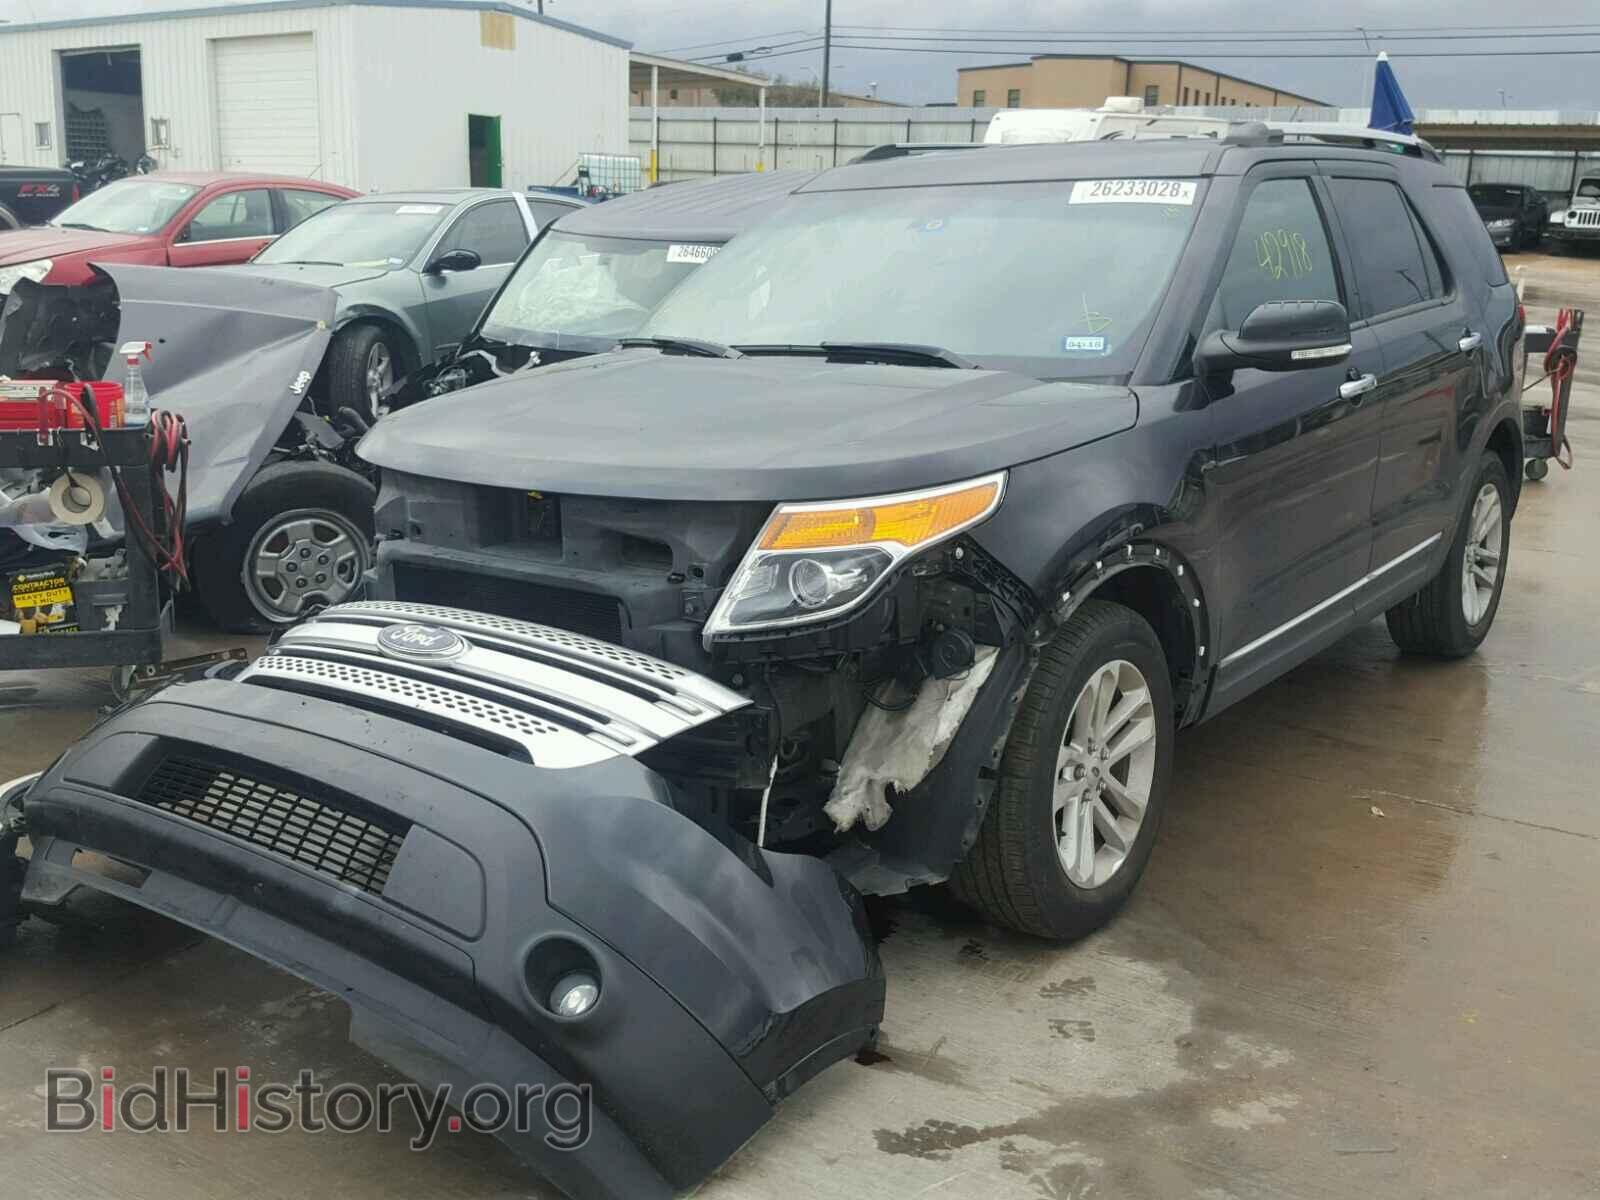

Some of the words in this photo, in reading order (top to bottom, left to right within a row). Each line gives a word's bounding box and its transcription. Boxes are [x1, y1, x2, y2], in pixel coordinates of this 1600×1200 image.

[20, 182, 60, 192] FX4
[1090, 181, 1181, 198] 26233028
[289, 371, 311, 394] Jeep
[16, 593, 43, 601] HEAVY
[46, 588, 68, 597] DUTY
[390, 626, 445, 646] Ford
